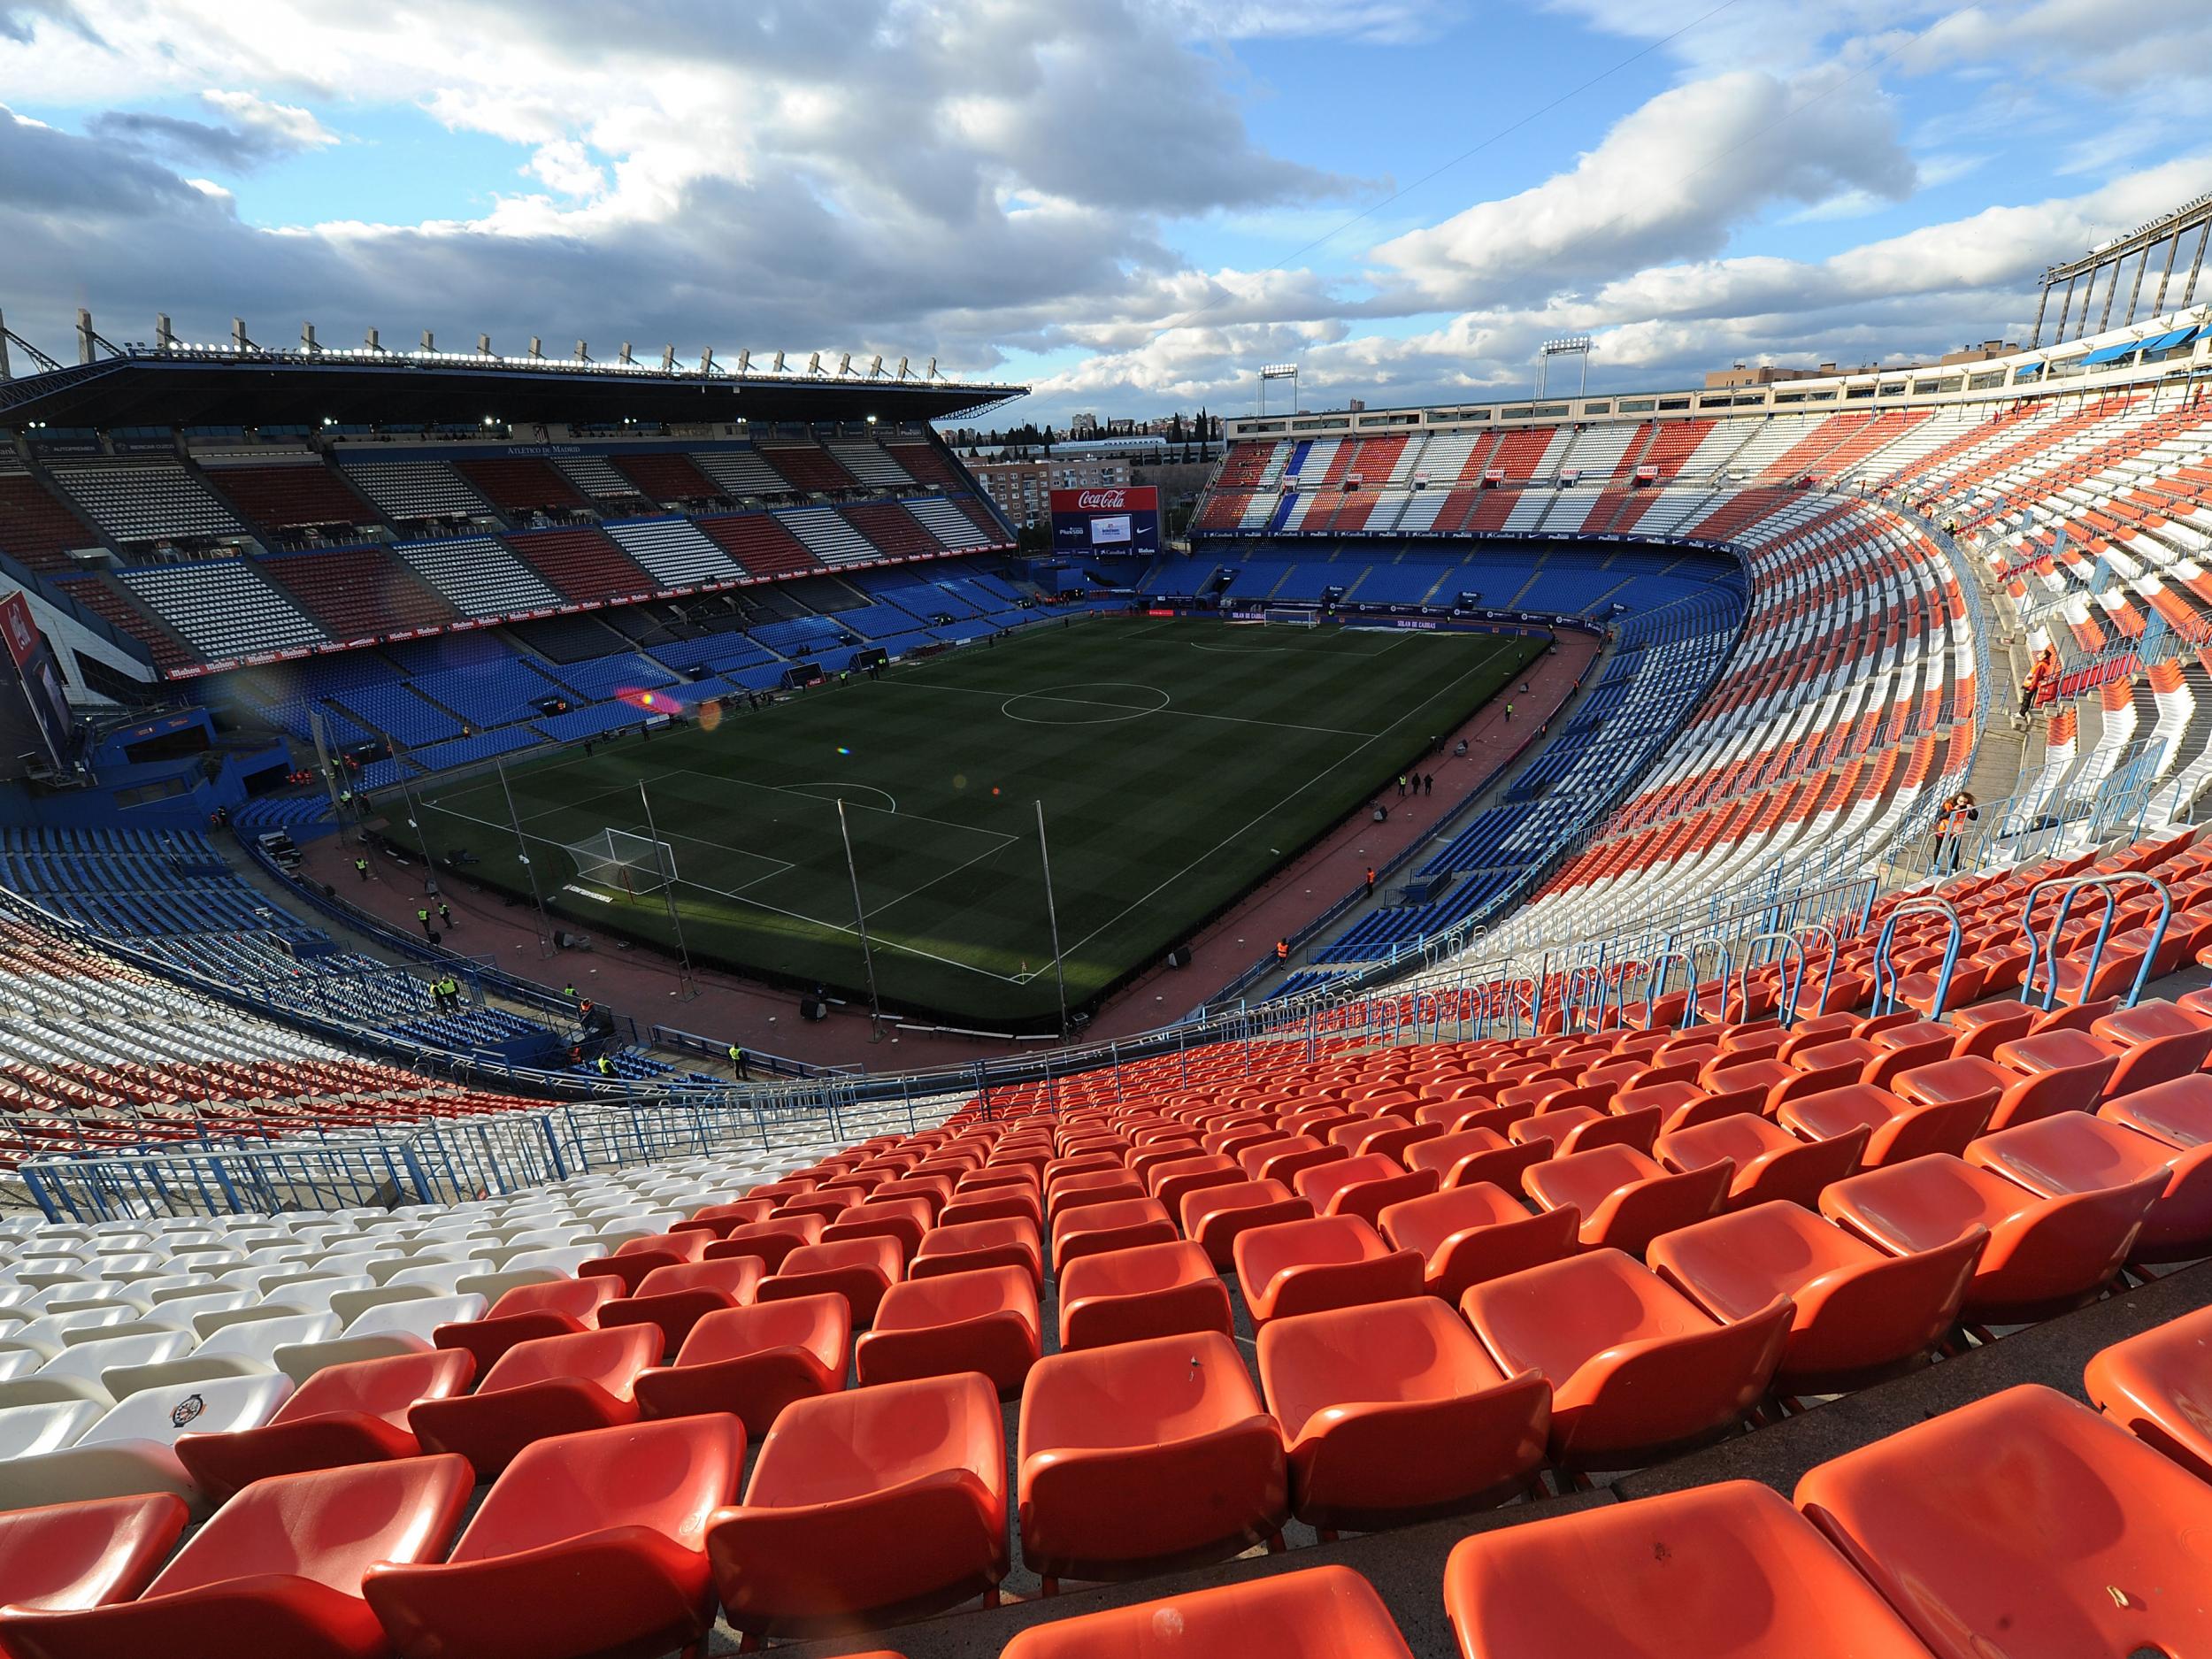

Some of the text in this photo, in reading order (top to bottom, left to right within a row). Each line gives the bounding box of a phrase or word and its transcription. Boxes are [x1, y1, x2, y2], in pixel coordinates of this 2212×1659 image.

[1079, 490, 1126, 508] Coca-Cola
[417, 626, 440, 634] Mahou
[320, 641, 346, 651] Mahou
[247, 647, 308, 664] Mahou Mahou
[170, 659, 235, 677] Mahou Mahou
